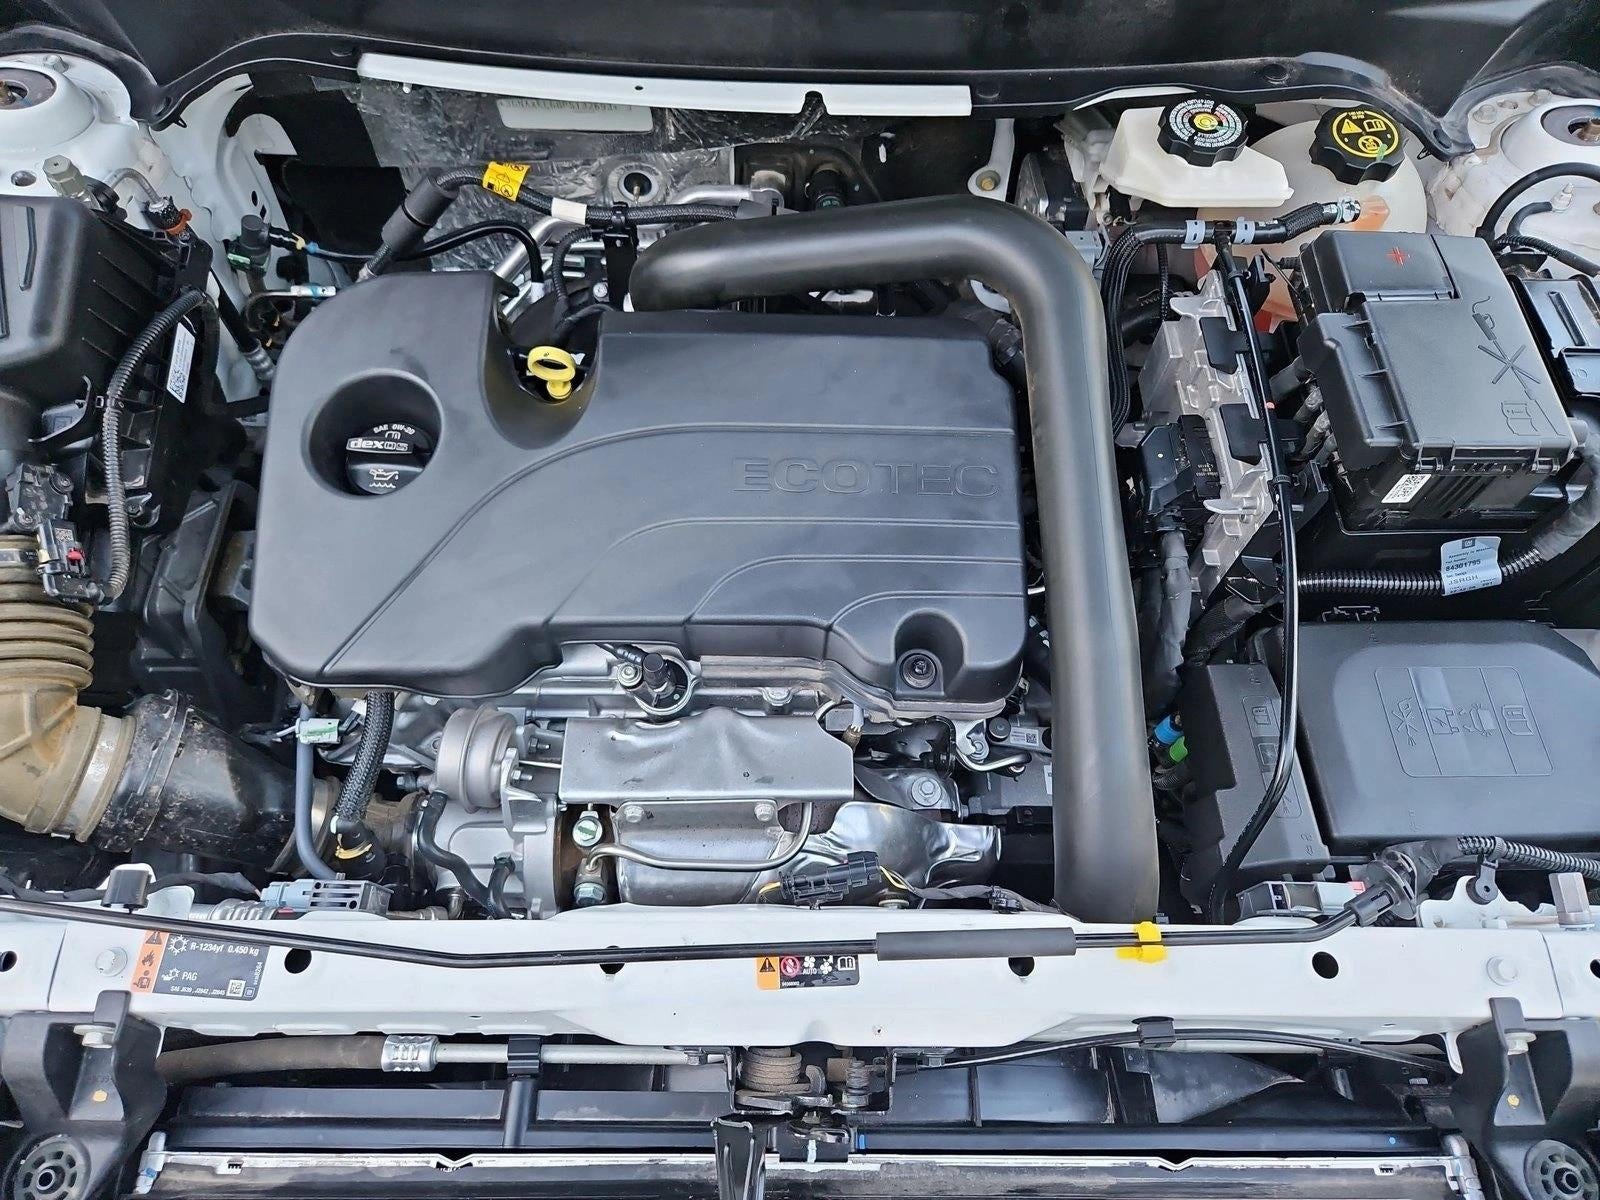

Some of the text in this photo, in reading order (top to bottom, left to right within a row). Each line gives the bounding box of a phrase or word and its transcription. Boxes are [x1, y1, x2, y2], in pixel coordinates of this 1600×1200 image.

[373, 423, 416, 435] SAE 0W-20
[350, 438, 408, 451] dexos
[732, 456, 1000, 498] ECOTEC
[190, 942, 260, 957] R-1234yf 0.450 kg
[182, 971, 199, 981] PAG
